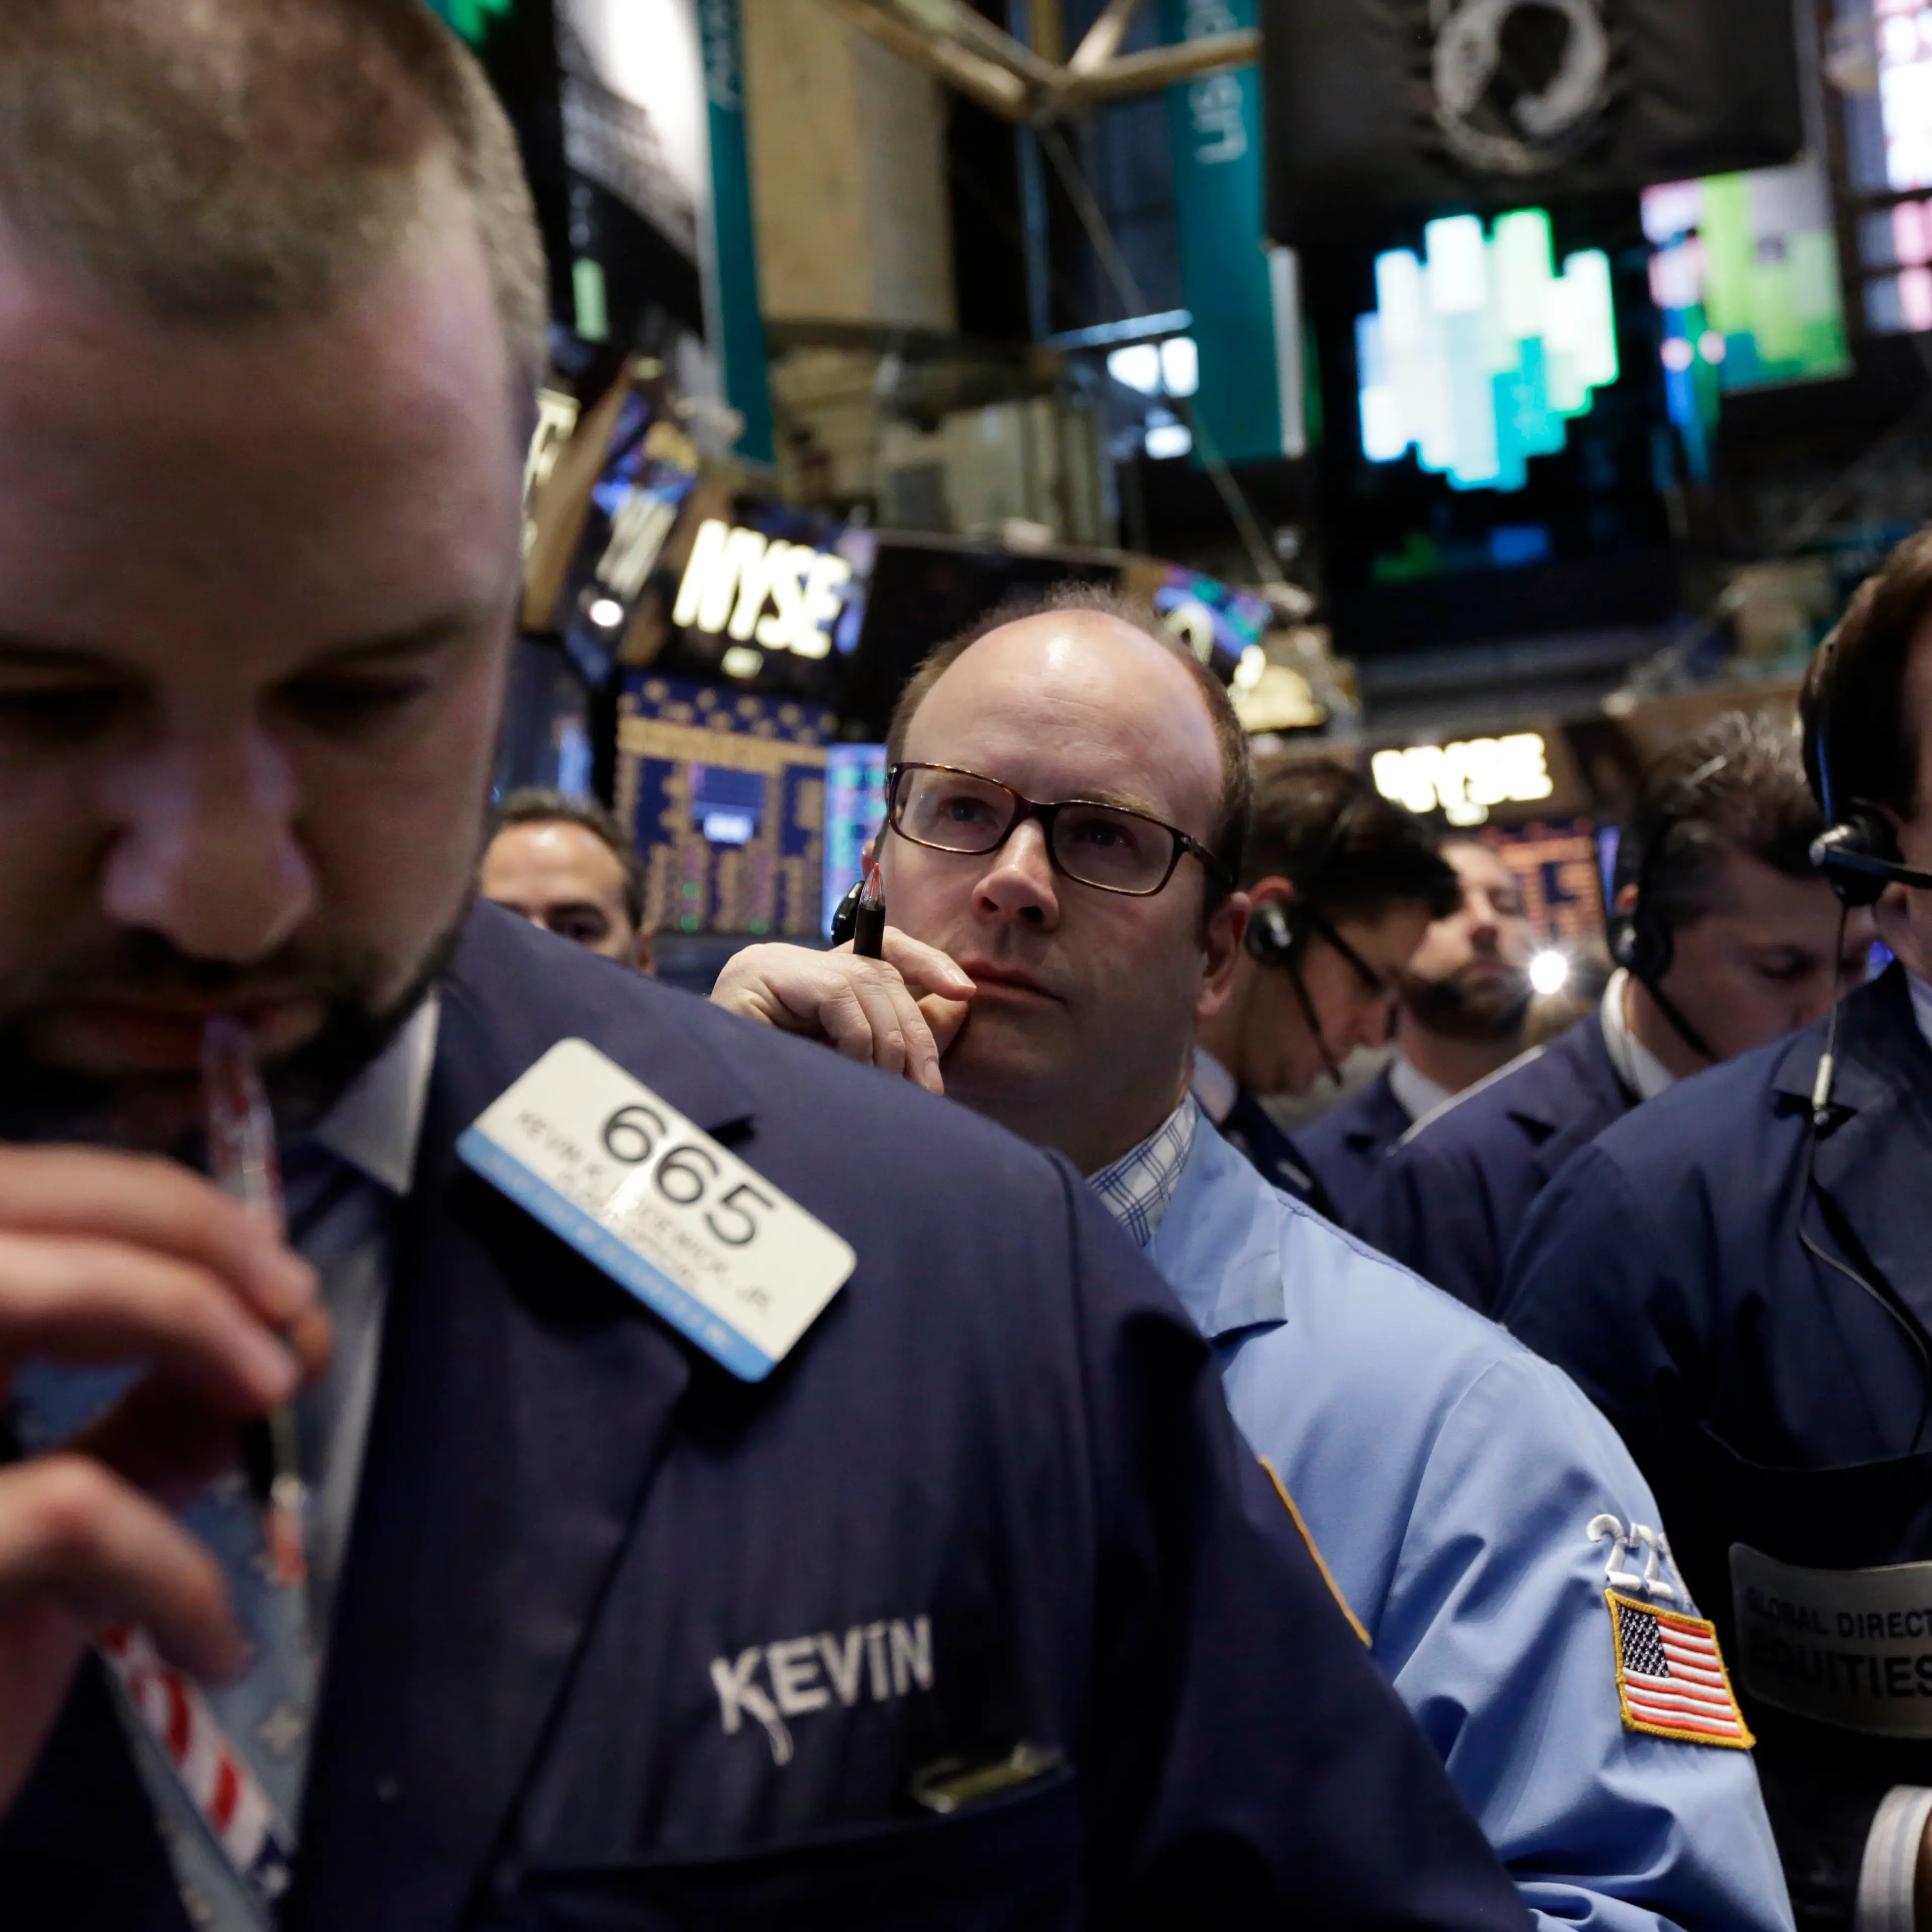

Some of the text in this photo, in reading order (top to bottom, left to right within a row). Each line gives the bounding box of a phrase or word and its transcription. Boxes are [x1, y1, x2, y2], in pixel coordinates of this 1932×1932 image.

[673, 519, 853, 660] NYSE
[599, 1103, 775, 1247] 665
[709, 1613, 935, 1766] KEVIN
